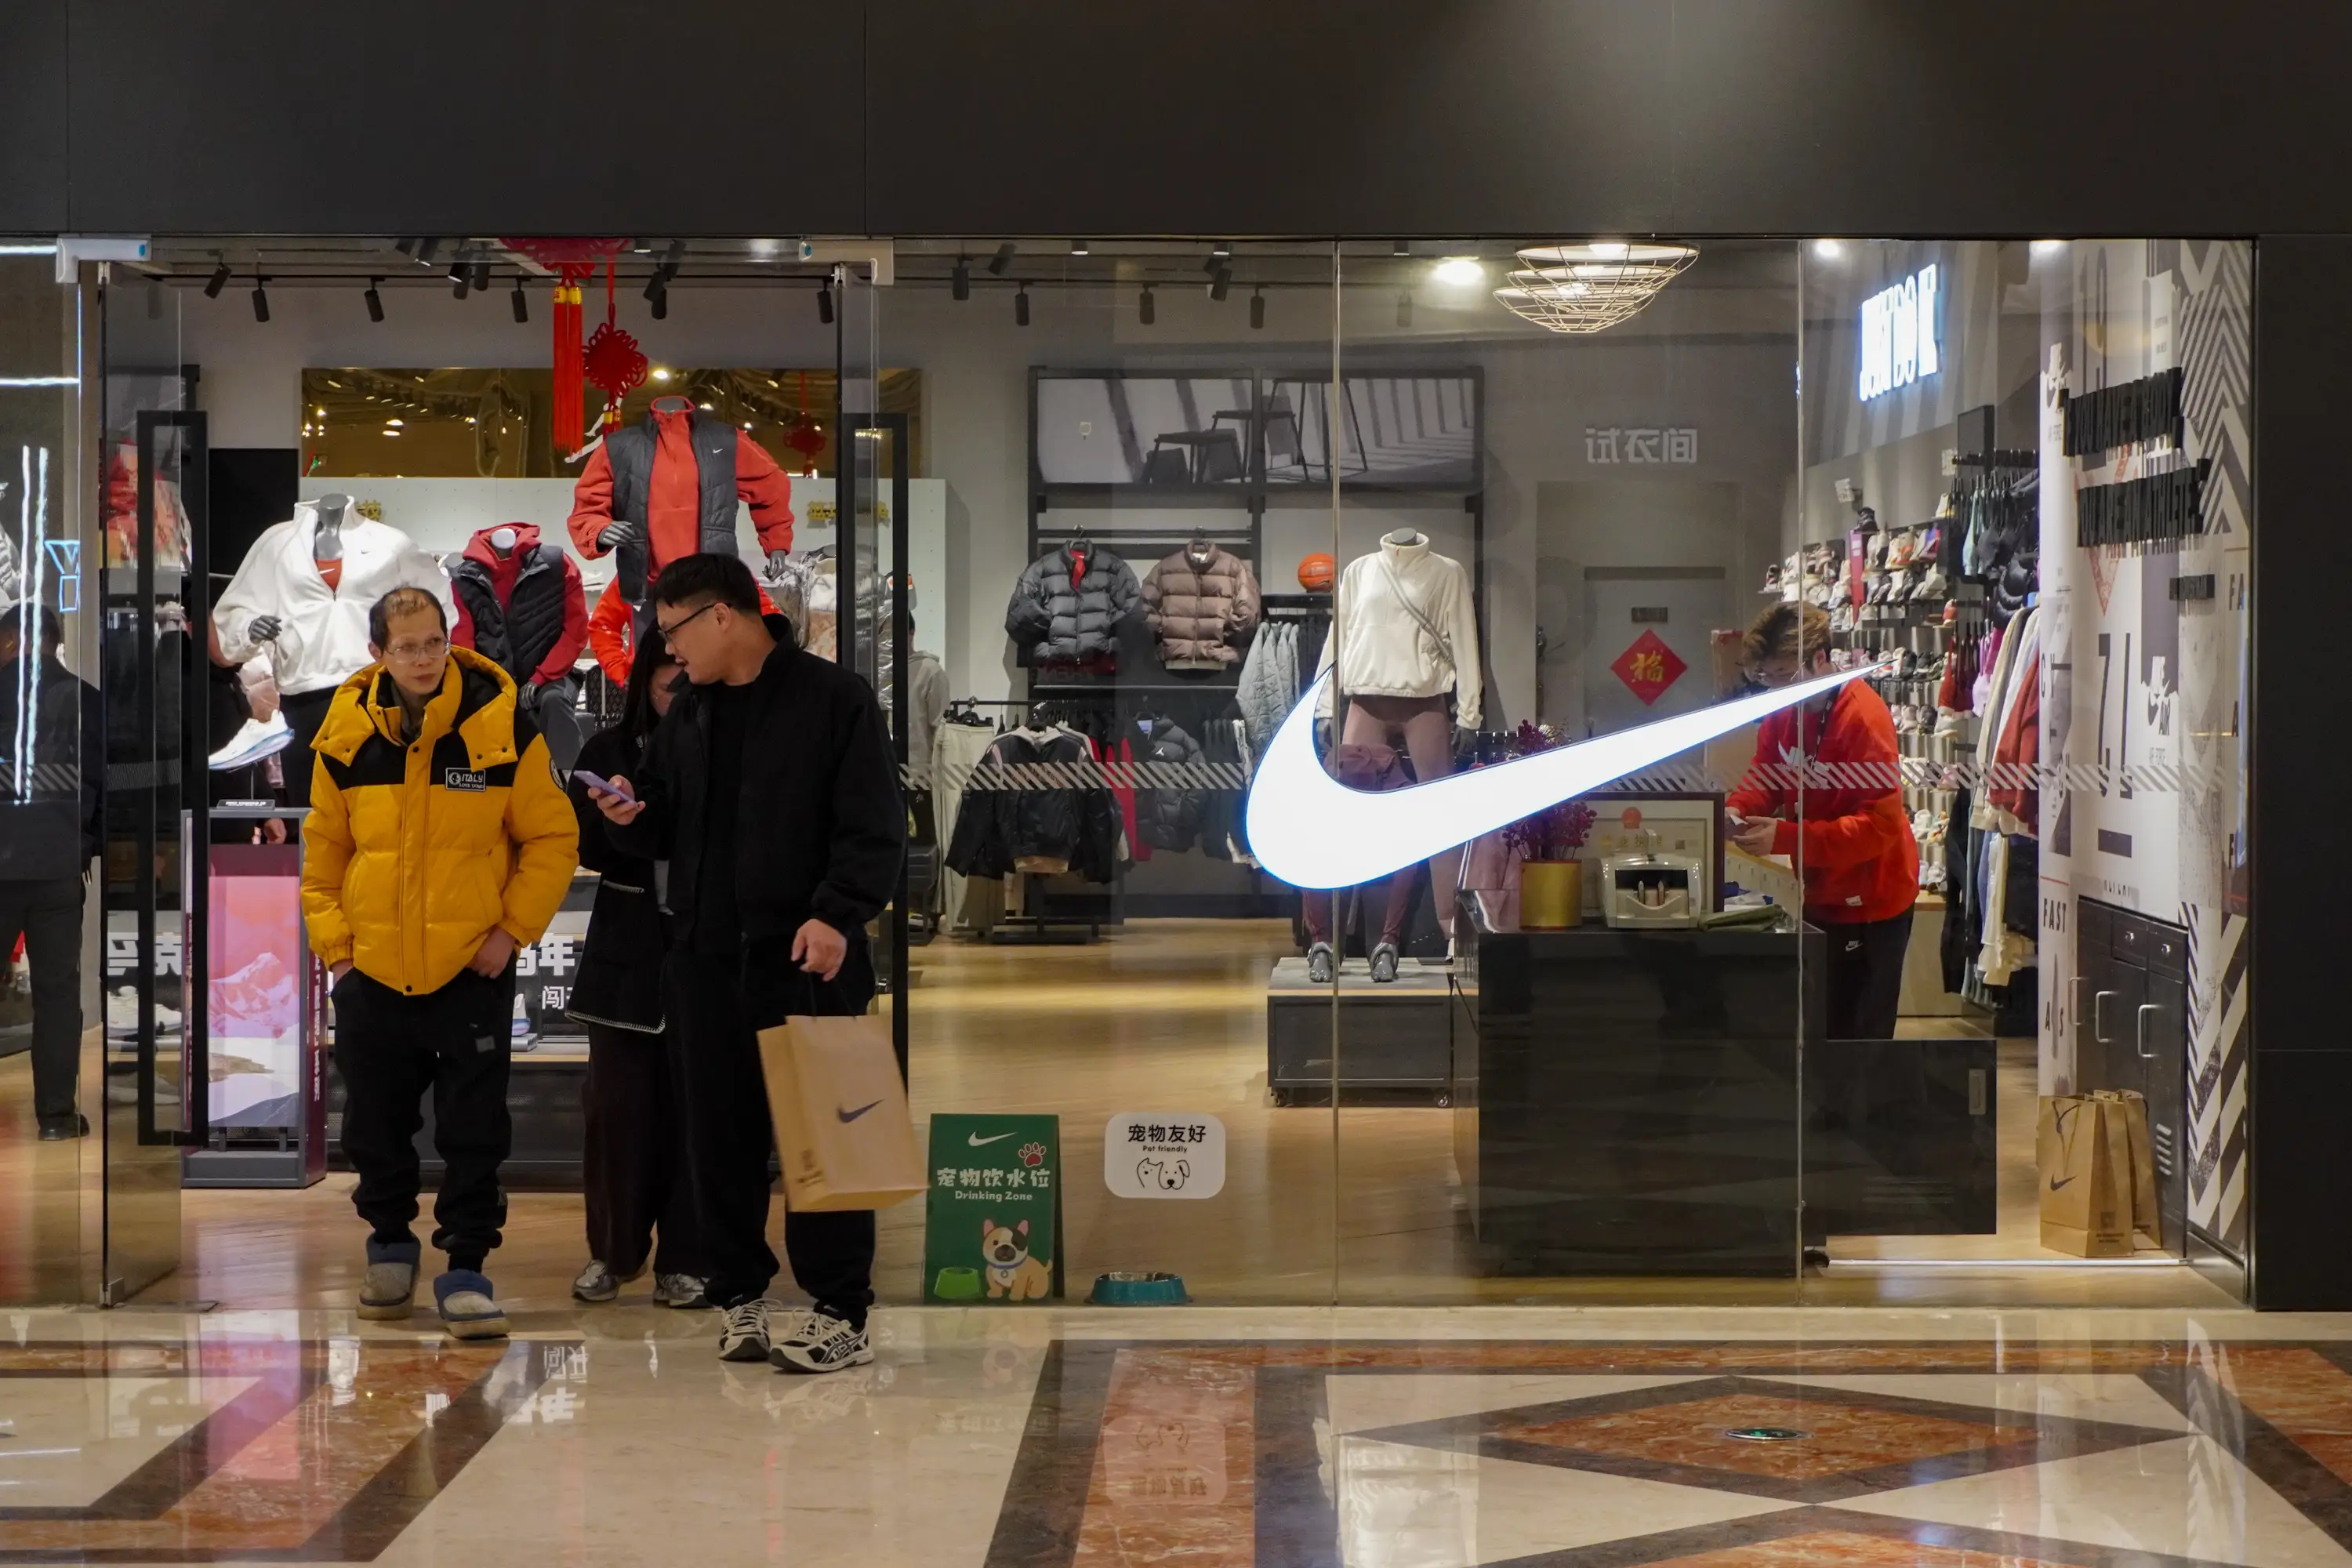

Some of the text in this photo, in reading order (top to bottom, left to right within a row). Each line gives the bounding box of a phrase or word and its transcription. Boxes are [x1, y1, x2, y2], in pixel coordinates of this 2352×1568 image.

[1585, 427, 1697, 463] 试衣间
[462, 773, 484, 783] ITALY
[2043, 897, 2067, 934] FAST
[1127, 1123, 1207, 1143] 宠物友好
[1158, 1145, 1188, 1153] friendly
[936, 1167, 1051, 1188] 宠物饮水位
[955, 1190, 1033, 1203] Drinking Zone
